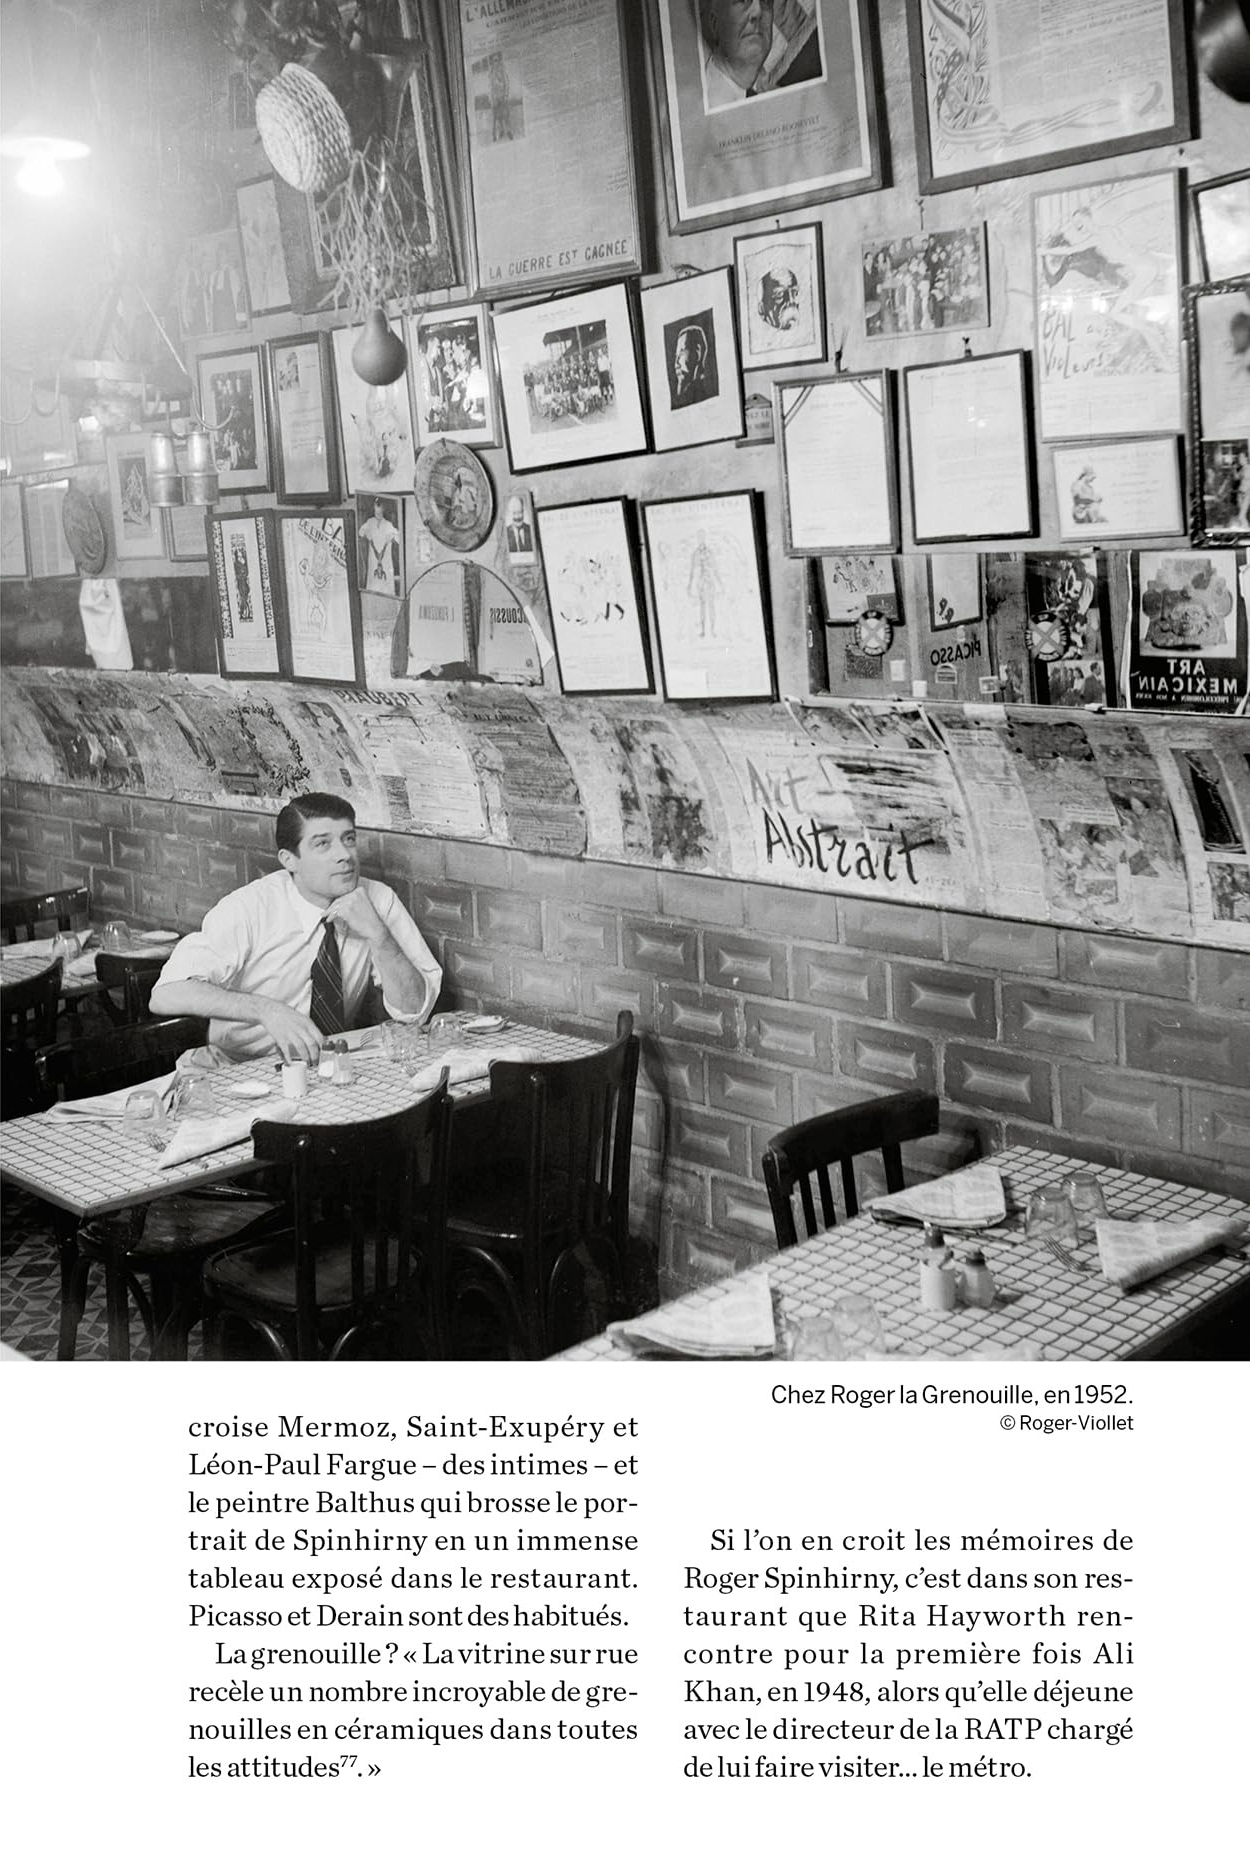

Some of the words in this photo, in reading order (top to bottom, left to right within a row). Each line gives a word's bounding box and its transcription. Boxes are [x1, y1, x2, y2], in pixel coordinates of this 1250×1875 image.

[489, 266, 501, 279] LA
[508, 256, 552, 276] GUERRE
[747, 758, 808, 814] Art
[772, 1385, 825, 1404] Chez
[832, 1385, 895, 1408] Roger
[901, 1385, 917, 1404] la
[923, 1385, 1038, 1406] Grenouille,
[1044, 1390, 1069, 1404] en
[1075, 1385, 1132, 1404] 1952.
[189, 1415, 268, 1437] croise
[278, 1416, 396, 1441] Mermoz,
[407, 1415, 605, 1443] Saint-Exupéry
[614, 1418, 638, 1437] et
[1000, 1415, 1015, 1430] ©
[1021, 1415, 1134, 1434] Roger-Viollet
[711, 1529, 734, 1550] Si
[744, 1529, 792, 1550] l’on
[802, 1536, 833, 1550] en
[843, 1529, 905, 1550] croit
[915, 1529, 950, 1550] les
[961, 1528, 1093, 1550] mémoires
[1103, 1529, 1133, 1550] de
[188, 1567, 284, 1588] tableau
[292, 1566, 382, 1594] exposé
[391, 1567, 452, 1588] dans
[461, 1567, 482, 1588] le
[491, 1569, 637, 1588] restaurant.
